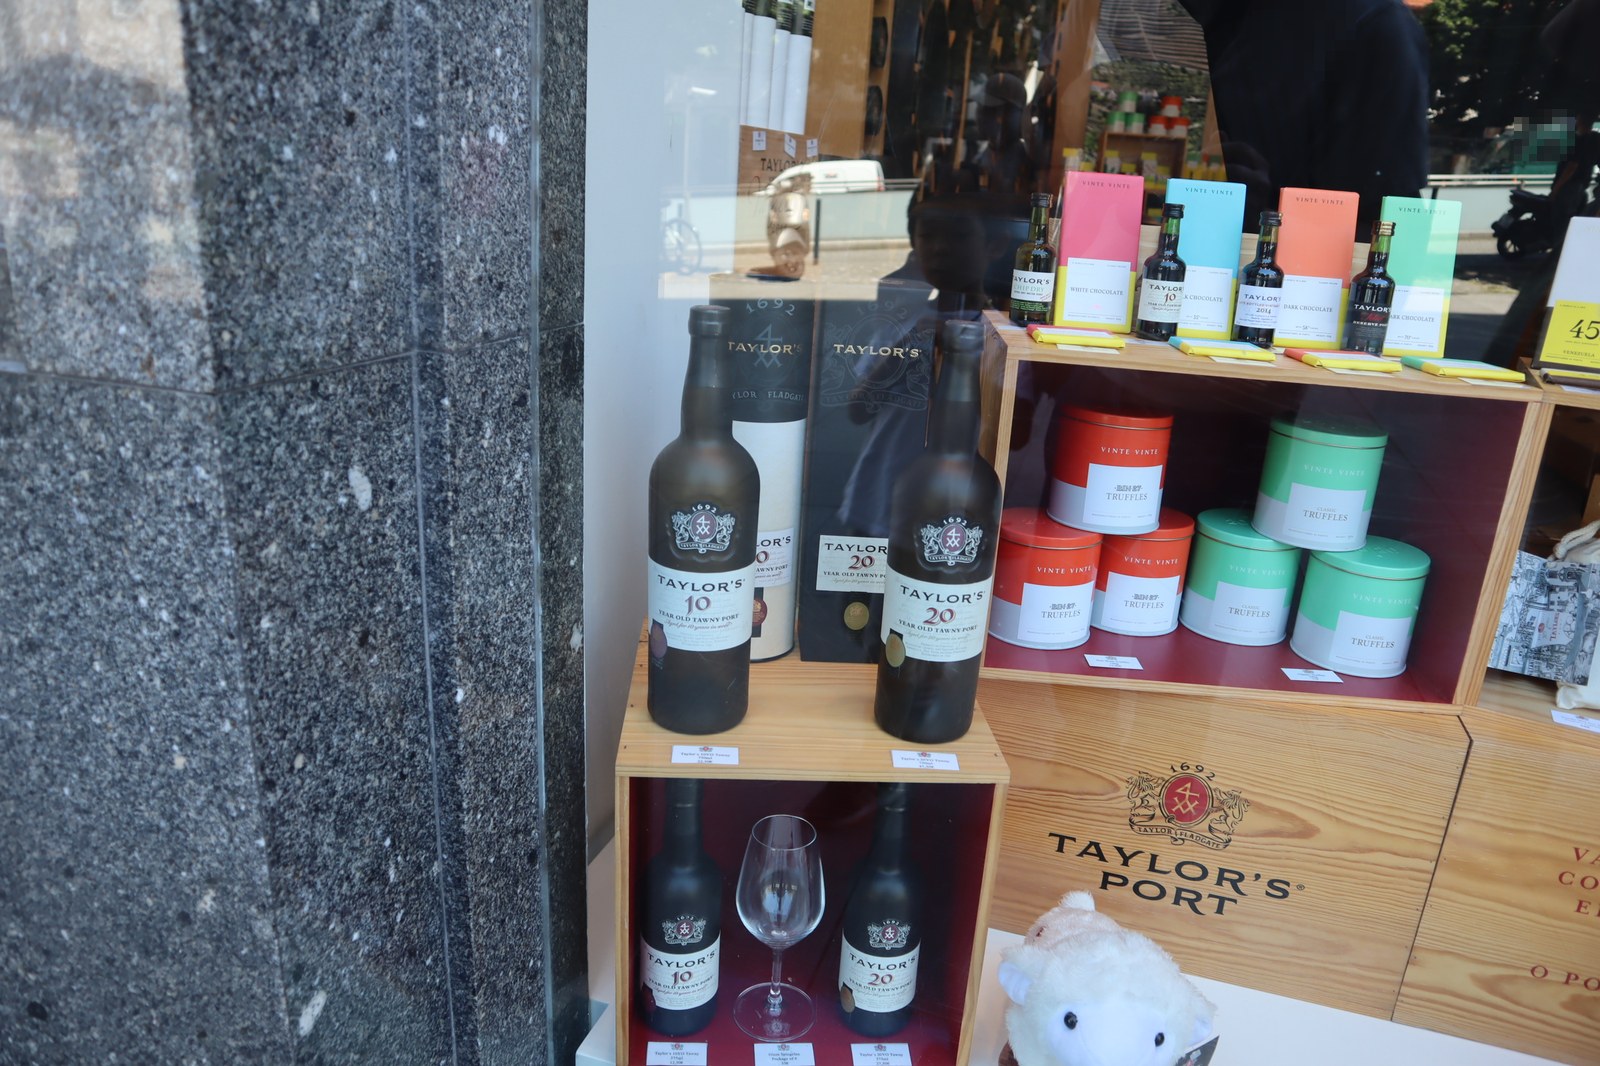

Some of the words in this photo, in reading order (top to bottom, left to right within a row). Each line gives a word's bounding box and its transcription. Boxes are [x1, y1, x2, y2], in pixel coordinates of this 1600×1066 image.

[1013, 276, 1050, 286] AYLOR'S
[1164, 292, 1176, 304] 10
[1190, 294, 1224, 302] CHOCOLATE
[746, 298, 795, 316] 1692
[1300, 304, 1332, 312] CHOCOLATE
[1402, 314, 1434, 322] CHOCOLATE
[728, 342, 803, 355] TAYLOR'S
[833, 344, 920, 358] TAYLOR'S
[1101, 446, 1130, 455] VINTE
[1304, 464, 1333, 474] VINTE
[1106, 492, 1148, 501] TRUFFLES
[692, 504, 717, 514] 1692
[943, 516, 968, 526] 1692
[1303, 510, 1349, 522] TRUFFLES
[756, 536, 792, 547] OR'S
[848, 554, 875, 570] 20
[1124, 556, 1152, 565] VINTE
[1036, 566, 1066, 574] VINTE
[1070, 566, 1092, 574] VINTE
[1230, 564, 1257, 575] VINTE
[658, 574, 743, 592] TAYLOR'S
[900, 584, 984, 604] TAYLOR'S
[1352, 592, 1382, 604] VINTE
[684, 595, 712, 616] 10
[1124, 600, 1164, 609] TRUFFLES
[658, 609, 674, 619] YEAR
[722, 614, 740, 622] PORT
[922, 607, 956, 626] 20
[1042, 610, 1081, 619] TRUFFLES
[1228, 606, 1271, 618] TRUFFLES
[898, 618, 916, 630] YEAR
[962, 624, 978, 632] PORT
[1352, 638, 1396, 649] TRUFFLES
[1170, 762, 1216, 781] 1692
[1138, 827, 1172, 835] TAYLOR
[1180, 831, 1221, 848] FLADGATE
[1558, 871, 1600, 890] CO
[1100, 870, 1238, 916] PORT
[648, 950, 715, 968] TAYLOR'S
[849, 952, 916, 971] TAYLOR'S
[648, 978, 662, 988] YEAR
[700, 976, 713, 985] PORT
[672, 970, 692, 986] 10
[868, 972, 893, 986] 20
